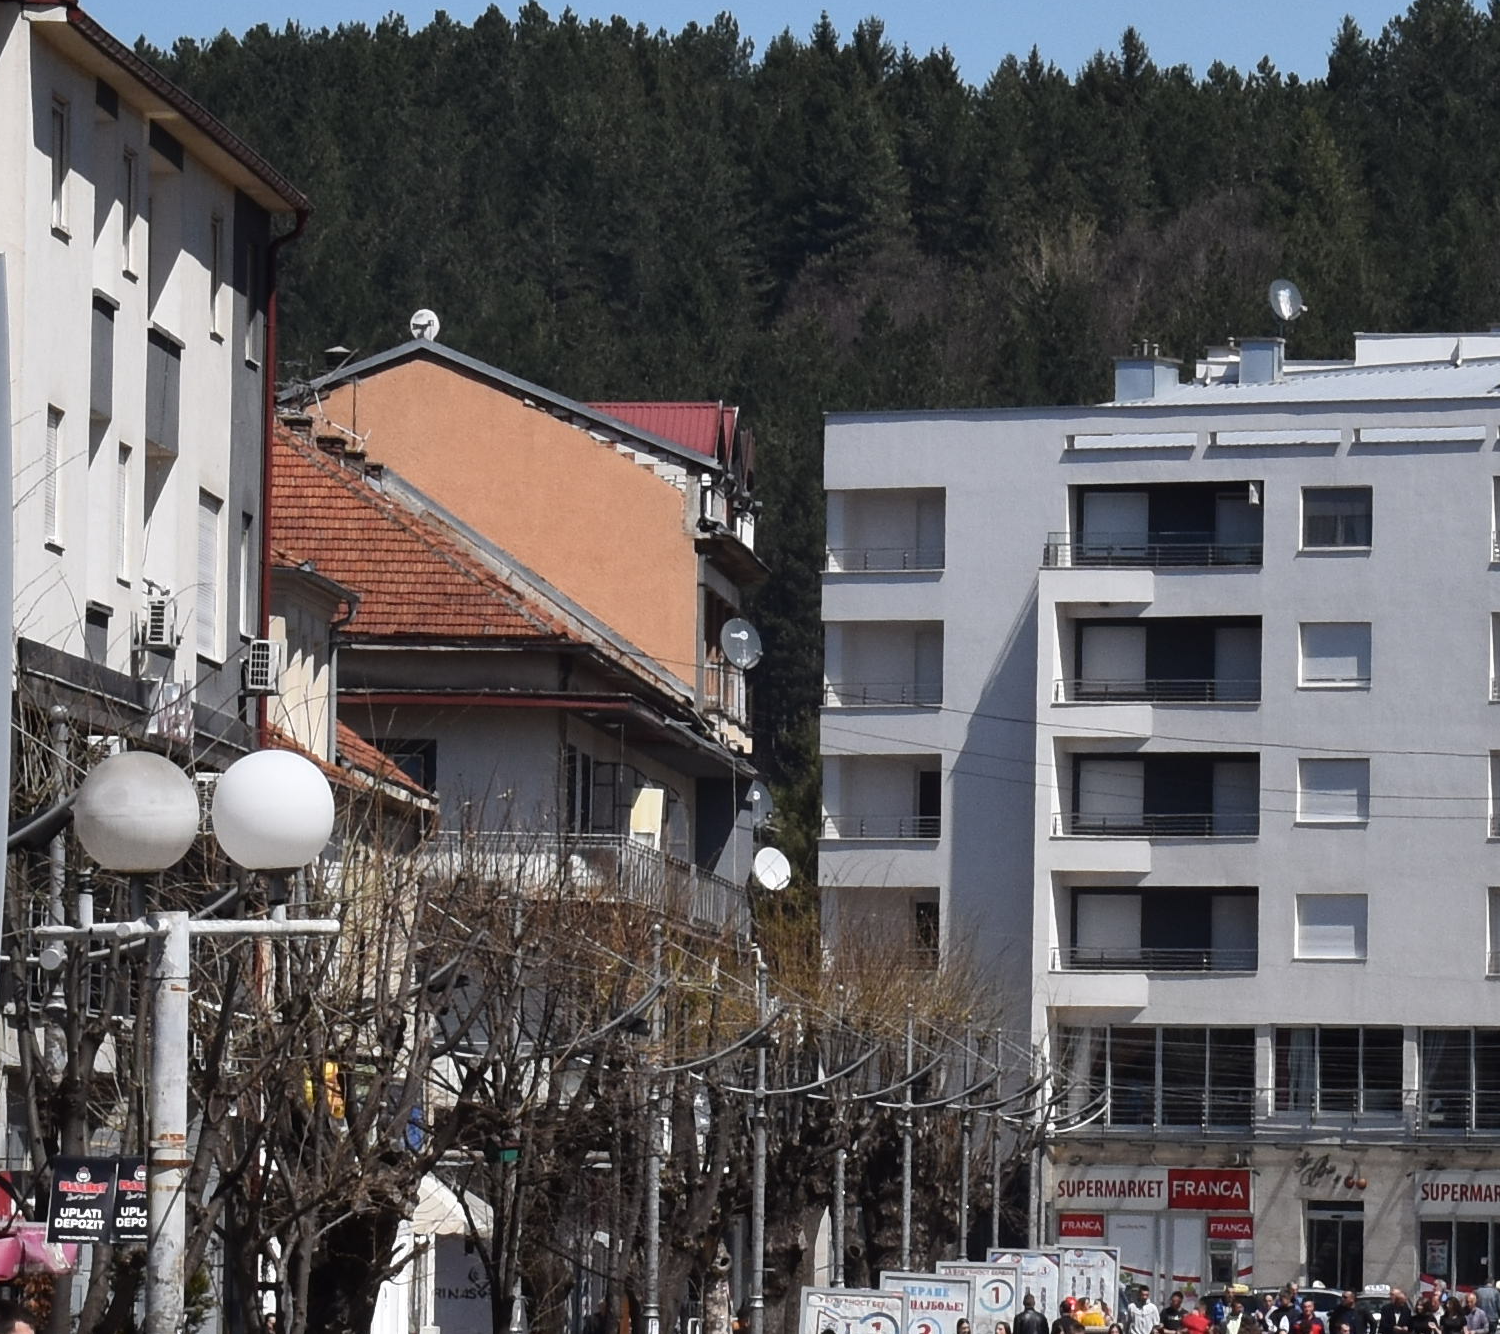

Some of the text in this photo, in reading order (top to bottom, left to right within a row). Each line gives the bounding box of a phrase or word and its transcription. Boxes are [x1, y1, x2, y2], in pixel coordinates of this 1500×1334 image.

[1057, 1179, 1244, 1199] SUPERMARKET FRANCA
[60, 1208, 102, 1218] UPLATI
[120, 1207, 148, 1217] UPL
[54, 1218, 105, 1230] DEPOZIT
[115, 1217, 148, 1228] DEPO
[1061, 1220, 1102, 1232] FRANCA
[1209, 1223, 1251, 1234] FRANCA
[991, 1286, 1000, 1304] 1
